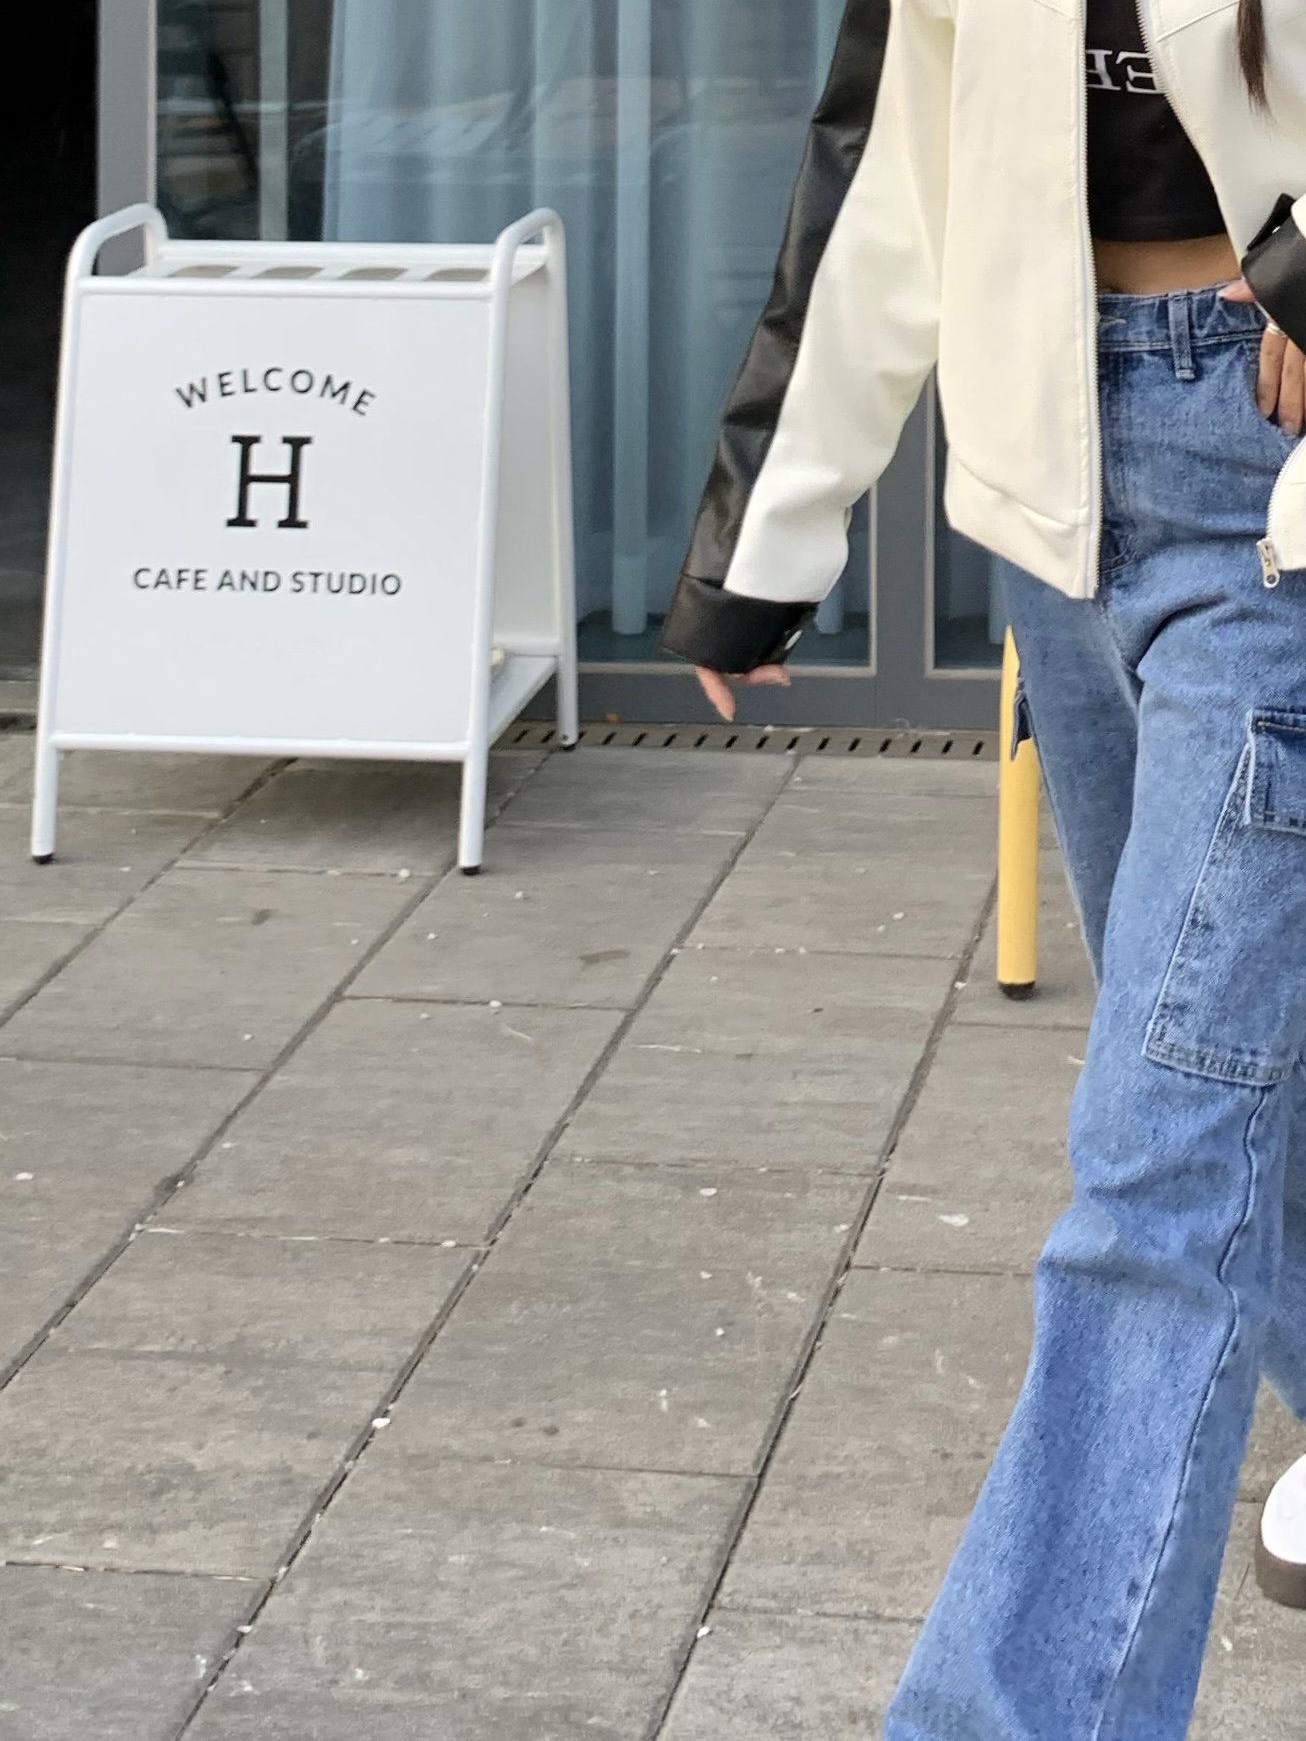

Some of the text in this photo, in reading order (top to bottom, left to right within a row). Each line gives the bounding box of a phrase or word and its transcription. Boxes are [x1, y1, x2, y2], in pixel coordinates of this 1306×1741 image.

[174, 366, 377, 417] WELCOME
[226, 434, 314, 529] H
[132, 567, 402, 596] CAFE AND STUDIO
